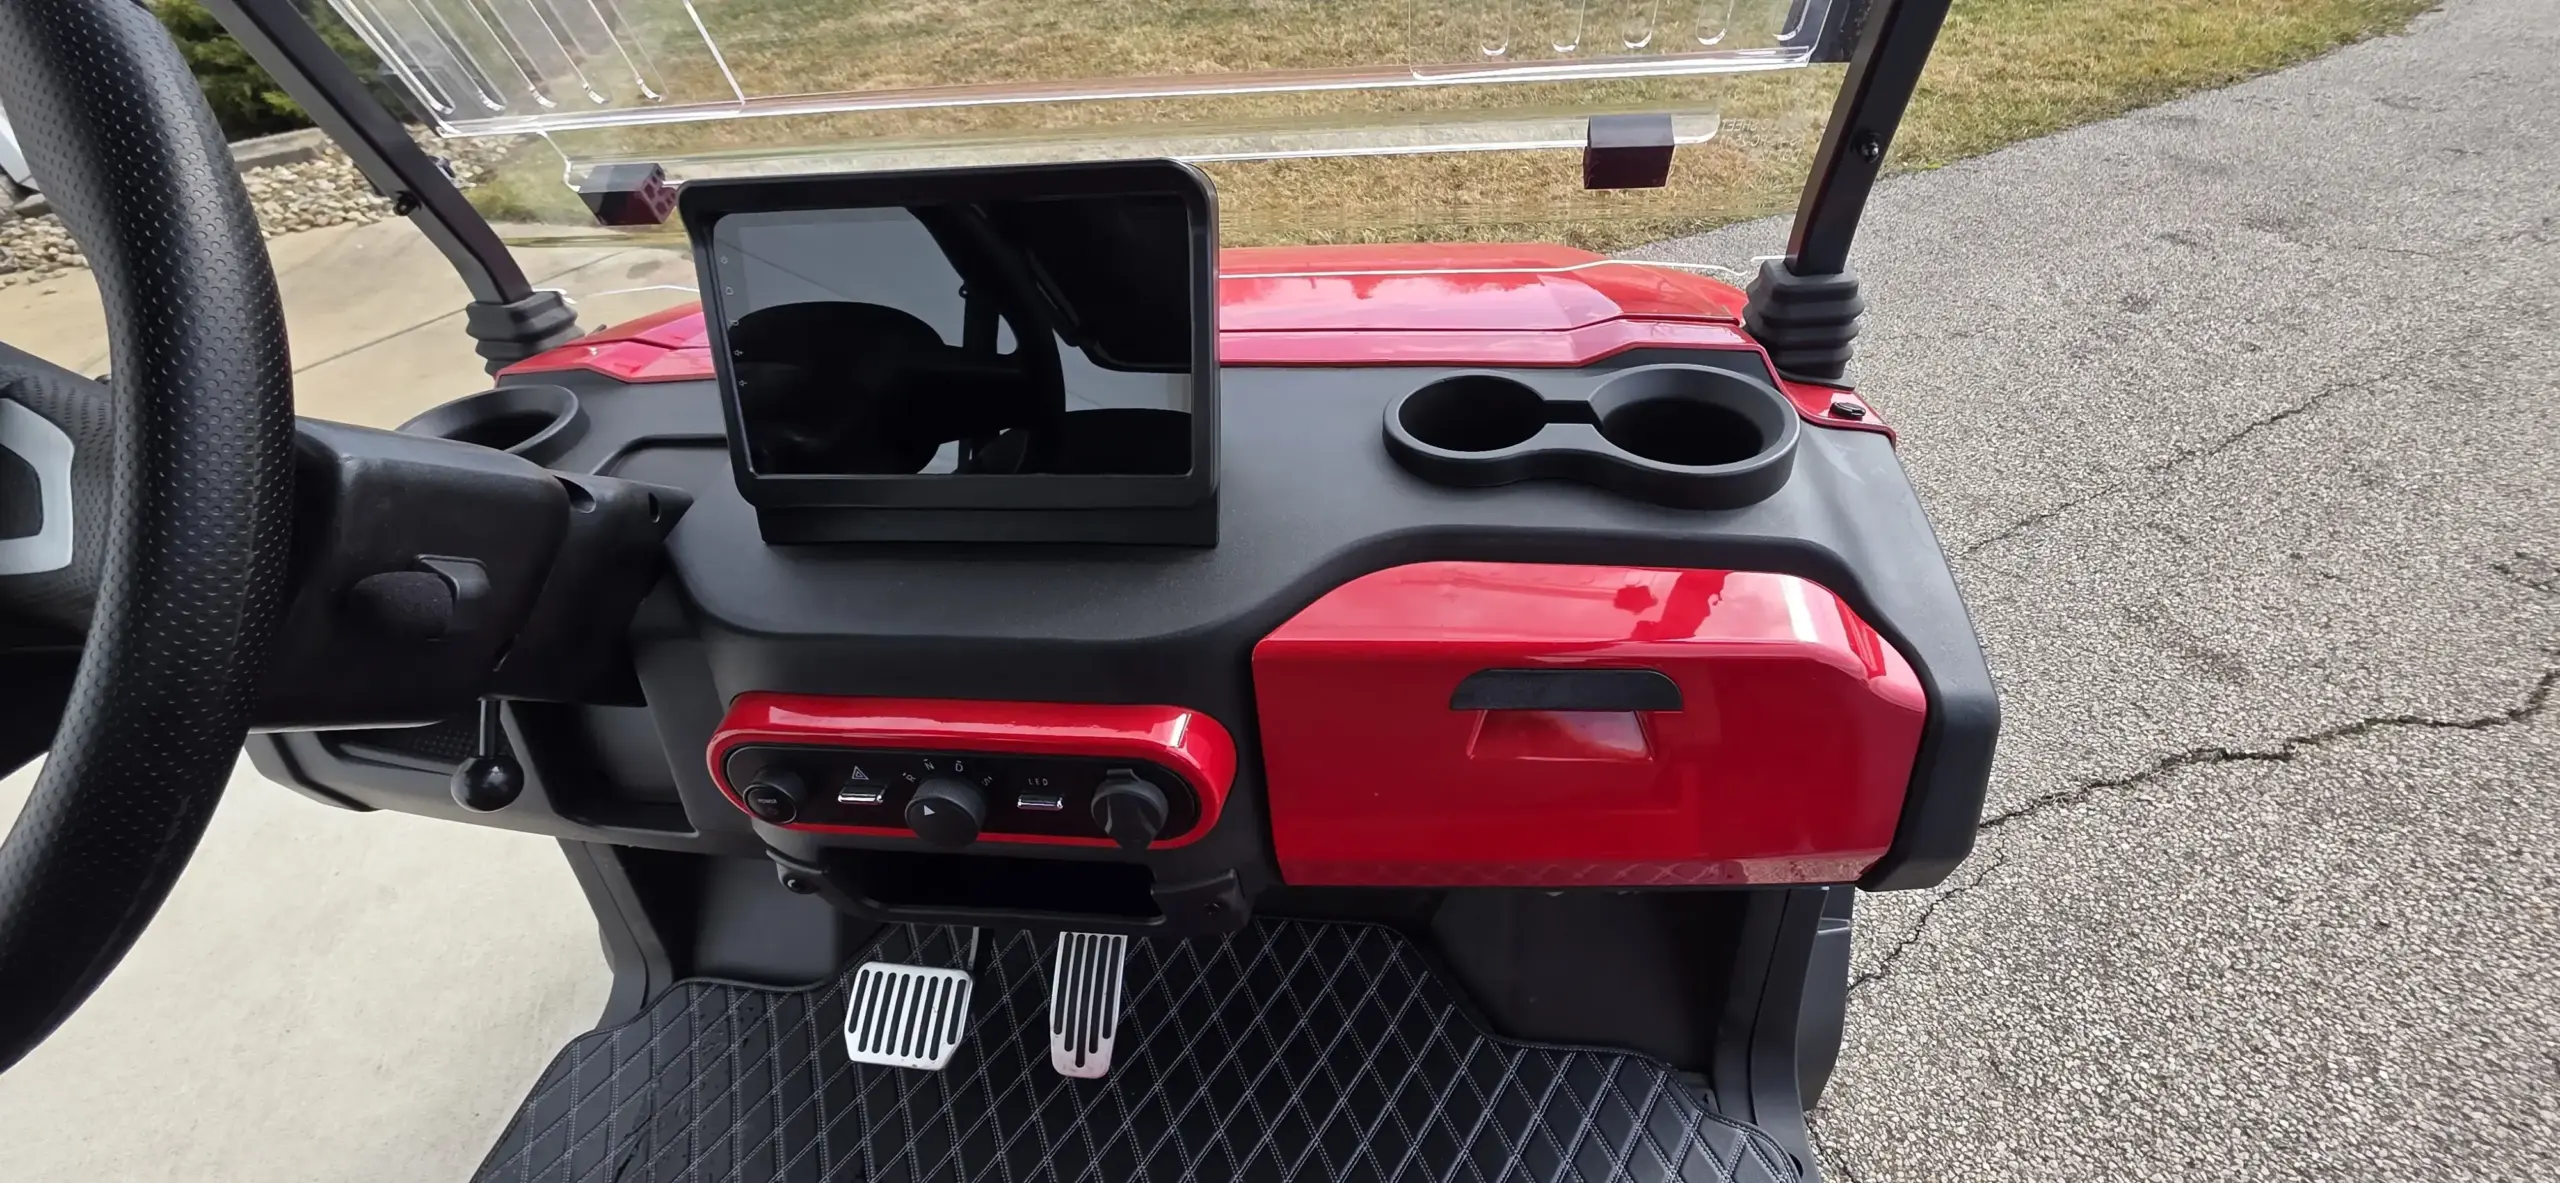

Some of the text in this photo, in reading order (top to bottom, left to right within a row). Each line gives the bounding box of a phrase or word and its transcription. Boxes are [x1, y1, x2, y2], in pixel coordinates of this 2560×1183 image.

[906, 774, 916, 783] R
[924, 761, 935, 771] N
[955, 763, 964, 772] D
[1028, 777, 1049, 786] LED
